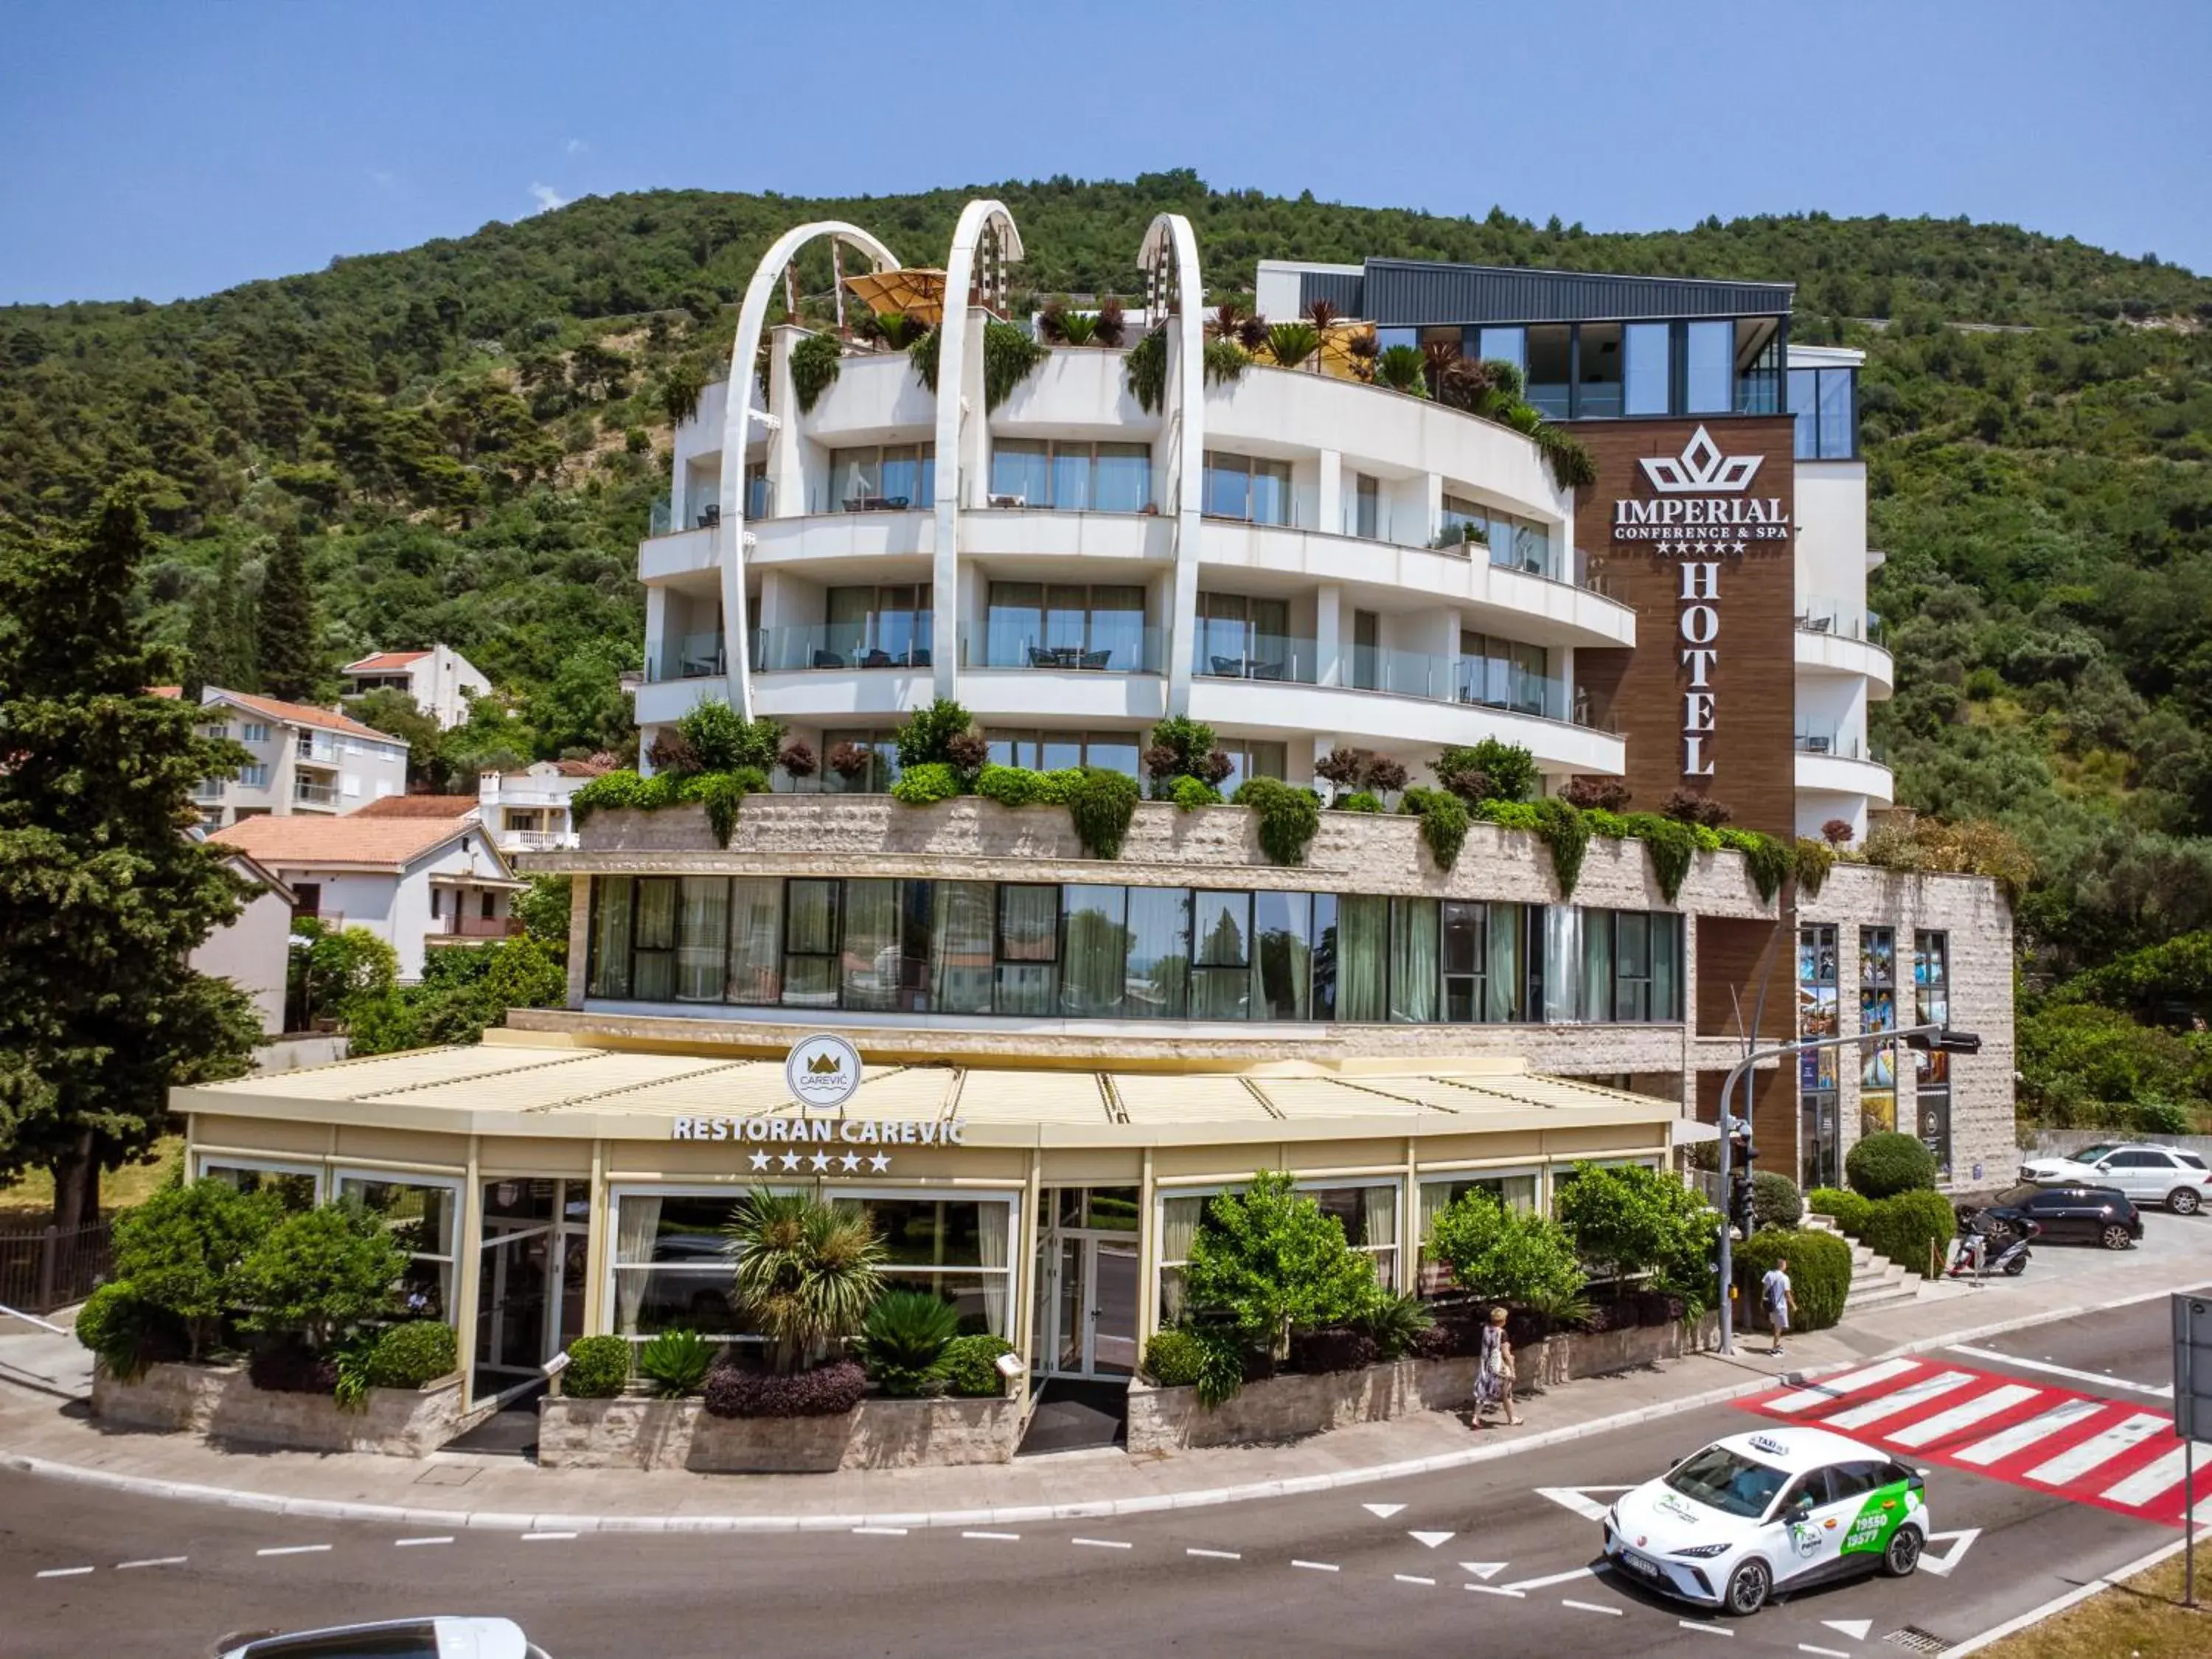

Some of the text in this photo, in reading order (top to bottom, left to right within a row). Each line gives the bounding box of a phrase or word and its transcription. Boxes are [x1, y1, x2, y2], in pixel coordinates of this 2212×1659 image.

[1615, 498, 1790, 524] IMPERIAL
[1615, 526, 1789, 539] CONFERENCE & SPA
[1679, 561, 1722, 776] HOTEL
[800, 1073, 847, 1085] CAREVIĆ
[672, 1116, 831, 1142] RESTORAN
[1758, 1436, 1777, 1448] TAXI
